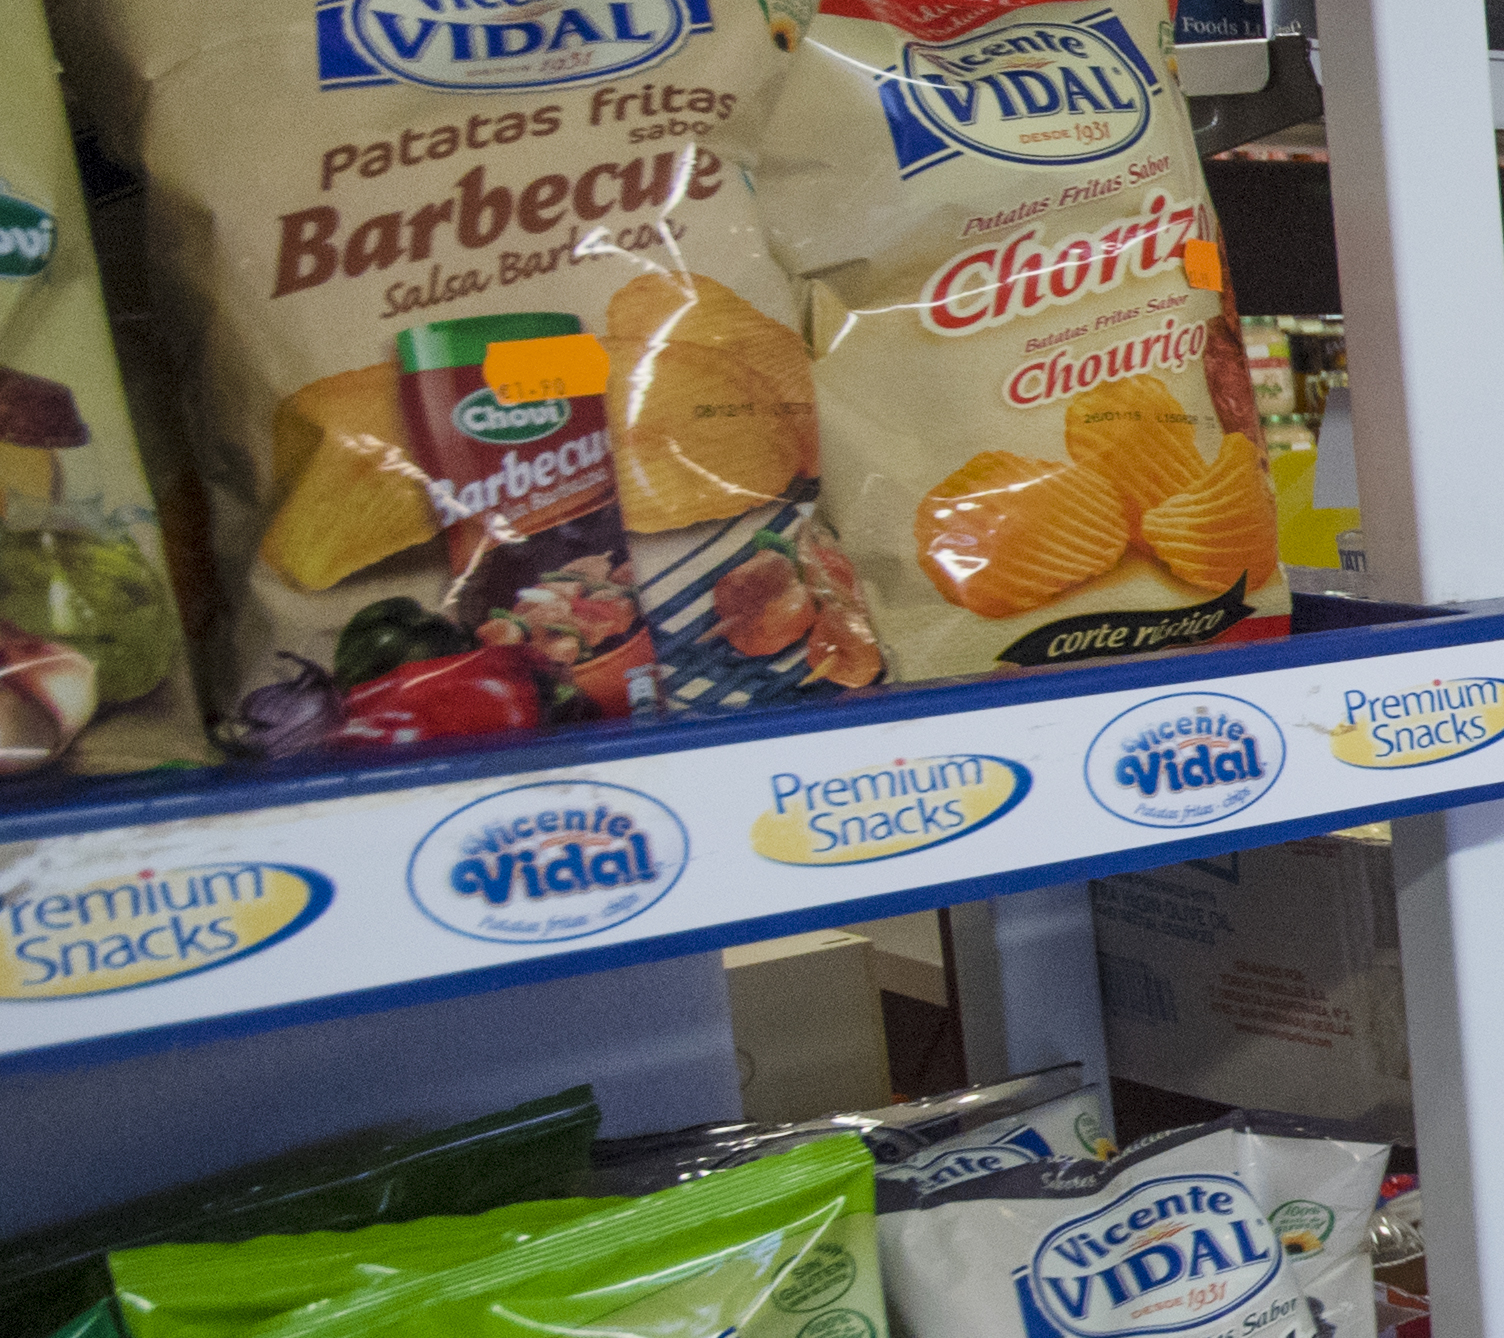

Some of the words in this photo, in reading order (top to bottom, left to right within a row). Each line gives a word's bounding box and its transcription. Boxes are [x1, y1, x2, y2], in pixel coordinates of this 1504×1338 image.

[370, 4, 655, 64] VIDAL
[933, 64, 1137, 127] VIDAL
[1018, 126, 1073, 147] DESDE
[1073, 120, 1112, 146] 1931
[270, 149, 723, 299] Barbecue
[960, 194, 1052, 239] Patatas
[1058, 173, 1124, 211] Fritas
[1127, 155, 1173, 189] Sabor
[1024, 320, 1093, 355] Batatas
[1094, 303, 1142, 335] Fritas
[1145, 291, 1191, 320] Sabor
[1007, 318, 1207, 407] Chouriço
[1046, 623, 1130, 661] corte
[1134, 609, 1227, 649] rústico
[1344, 679, 1499, 727] Premium
[1371, 712, 1488, 757] Snacks
[1115, 736, 1264, 796] Vidal
[810, 795, 967, 853] Snacks
[449, 835, 661, 907] Vidal
[14, 916, 240, 986] Snacks
[1053, 1186, 1236, 1266] Vicente
[1044, 1220, 1270, 1320] VIDAL
[1185, 1280, 1228, 1311] 1931
[1241, 1296, 1301, 1334] Sabor
